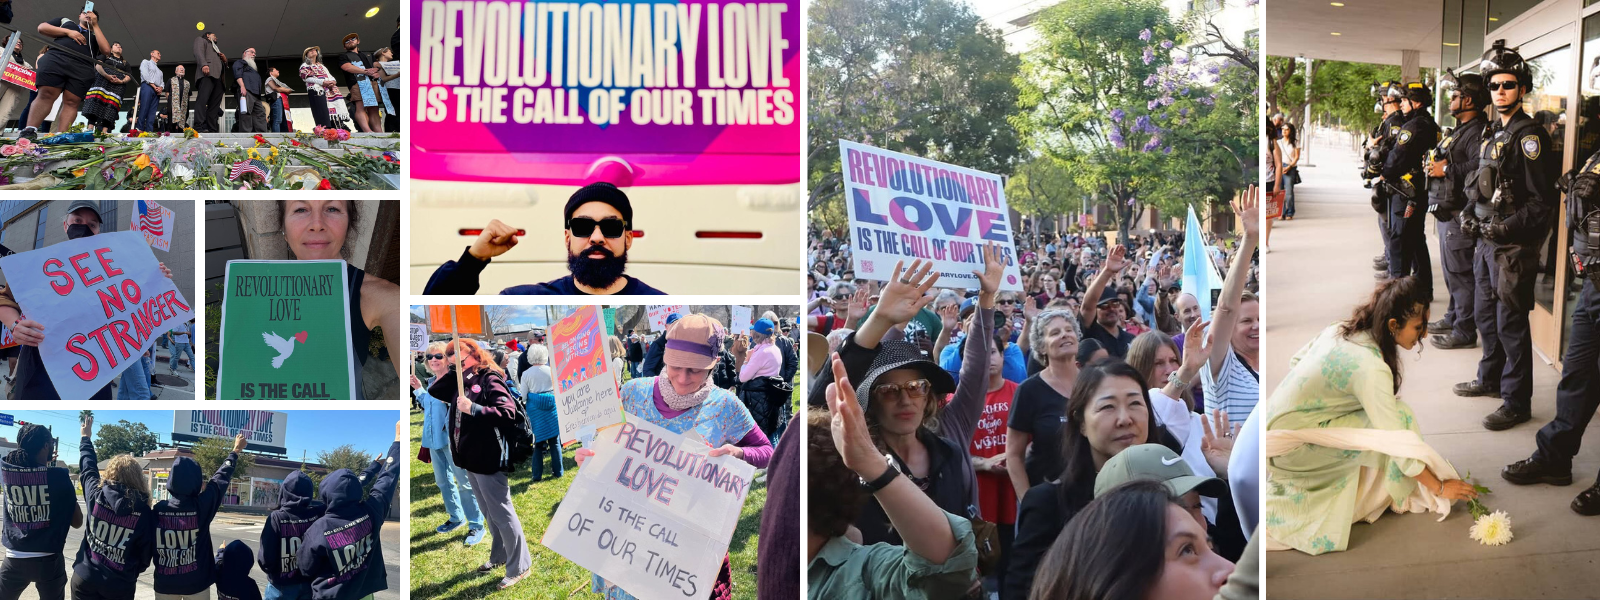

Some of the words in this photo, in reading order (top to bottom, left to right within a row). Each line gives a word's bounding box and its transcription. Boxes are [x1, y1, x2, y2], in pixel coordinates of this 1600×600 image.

[418, 0, 702, 88] REVOLUTIONARY
[706, 2, 790, 88] LOVE
[416, 86, 447, 123] IS
[452, 87, 508, 123] THE
[512, 88, 584, 125] CALL
[587, 89, 626, 125] OF
[630, 89, 694, 125] OUR
[697, 89, 795, 126] TIMES
[847, 148, 1000, 209] REVOLUTIONARY
[852, 187, 1009, 242] LOVE
[857, 227, 873, 251] IS
[874, 229, 900, 255] THE
[901, 234, 931, 259] CALL
[932, 238, 947, 260] OF
[949, 240, 976, 263] OUR
[976, 243, 1013, 267] TES
[43, 247, 124, 296] SEE
[235, 275, 334, 297] REVOLUTIONARY
[96, 279, 142, 319] NO
[268, 298, 301, 321] LOVE
[65, 290, 190, 381] STRANGER
[561, 329, 591, 350] BELONGING
[566, 339, 588, 355] BEGINS
[565, 349, 580, 362] WITH
[579, 344, 589, 355] US
[240, 382, 255, 398] IS
[258, 383, 288, 399] THE
[291, 382, 330, 399] CALL
[561, 393, 576, 408] you
[576, 383, 591, 397] are
[595, 387, 614, 402] here
[190, 422, 198, 433] IS
[200, 424, 212, 435] THE
[213, 426, 229, 438] CALL
[229, 429, 239, 438] OF
[239, 430, 252, 440] OUR
[253, 431, 273, 443] TIMES
[191, 410, 256, 431] REVOLUTIONARY
[256, 410, 274, 434] LOVE
[614, 422, 750, 501] REVOLUTIONARY
[615, 456, 679, 506] LOVE
[14, 505, 30, 522] THE
[30, 504, 51, 522] CALL
[598, 496, 614, 513] IS
[618, 506, 646, 532] THE
[648, 523, 678, 547] CALL
[89, 515, 135, 550] LOVE
[156, 527, 200, 550] LOVE
[106, 545, 126, 565] CALL
[165, 549, 179, 568] THE
[179, 544, 197, 566] CALL
[281, 558, 290, 573] IS
[568, 512, 594, 537] OF
[598, 528, 637, 565] OUR
[645, 550, 697, 597] TIMES
[178, 562, 198, 573] TIMES
